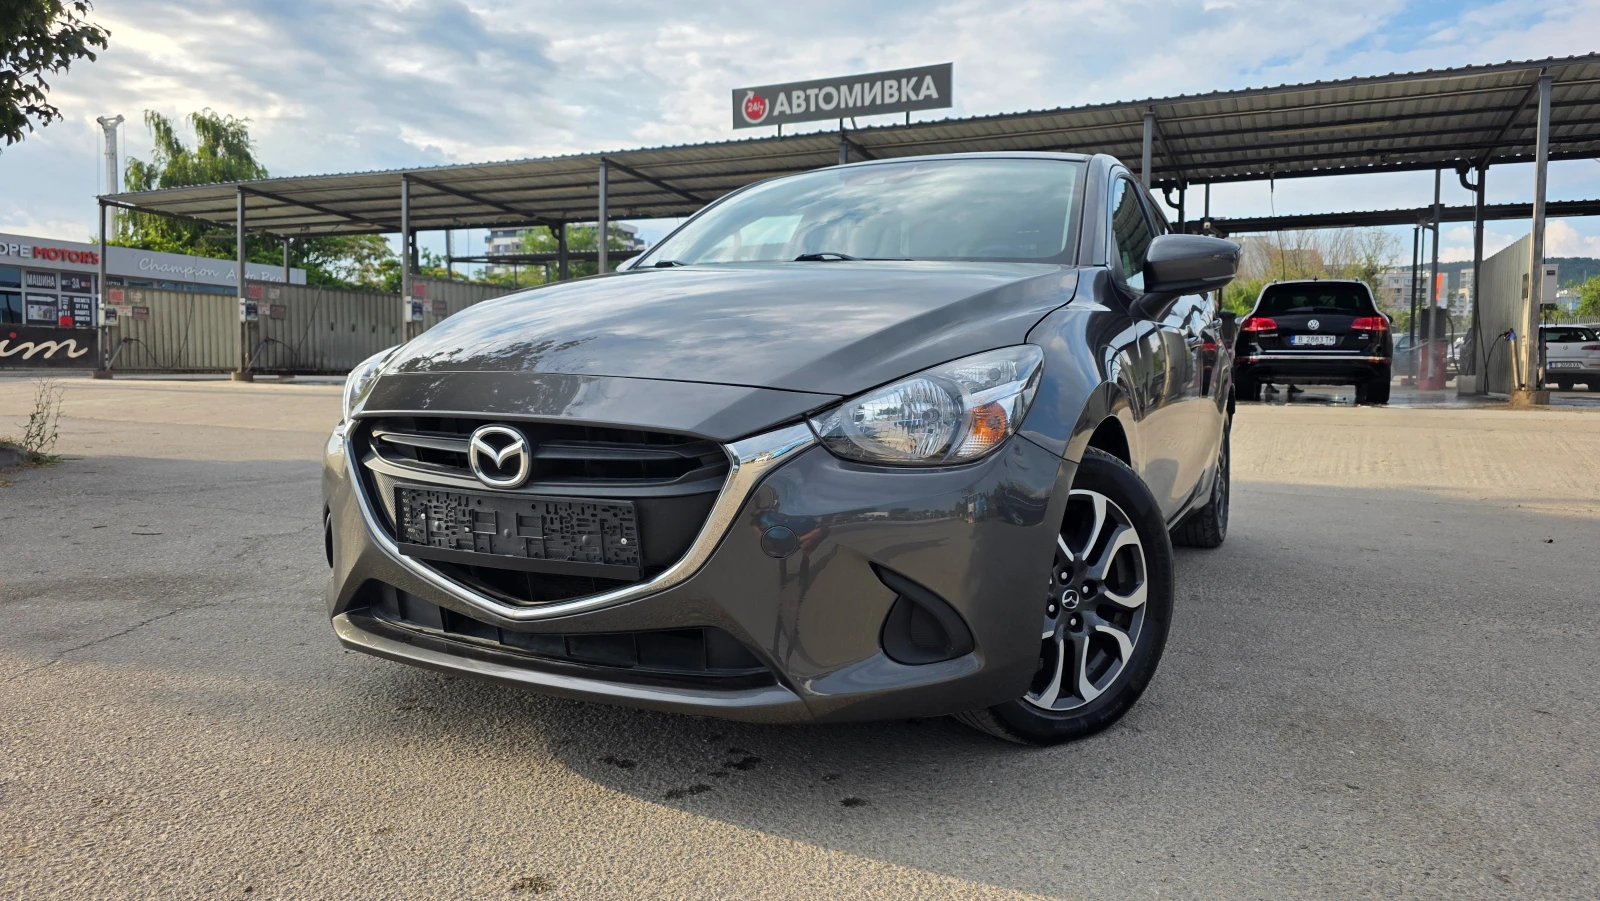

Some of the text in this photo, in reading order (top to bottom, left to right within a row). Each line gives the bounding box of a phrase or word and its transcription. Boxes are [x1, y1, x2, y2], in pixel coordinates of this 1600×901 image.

[772, 75, 939, 116] АВТОМИВКА
[747, 101, 765, 116] 24/7
[138, 257, 219, 278] Champion
[26, 273, 56, 287] МАШИНА
[71, 277, 80, 289] ЗА
